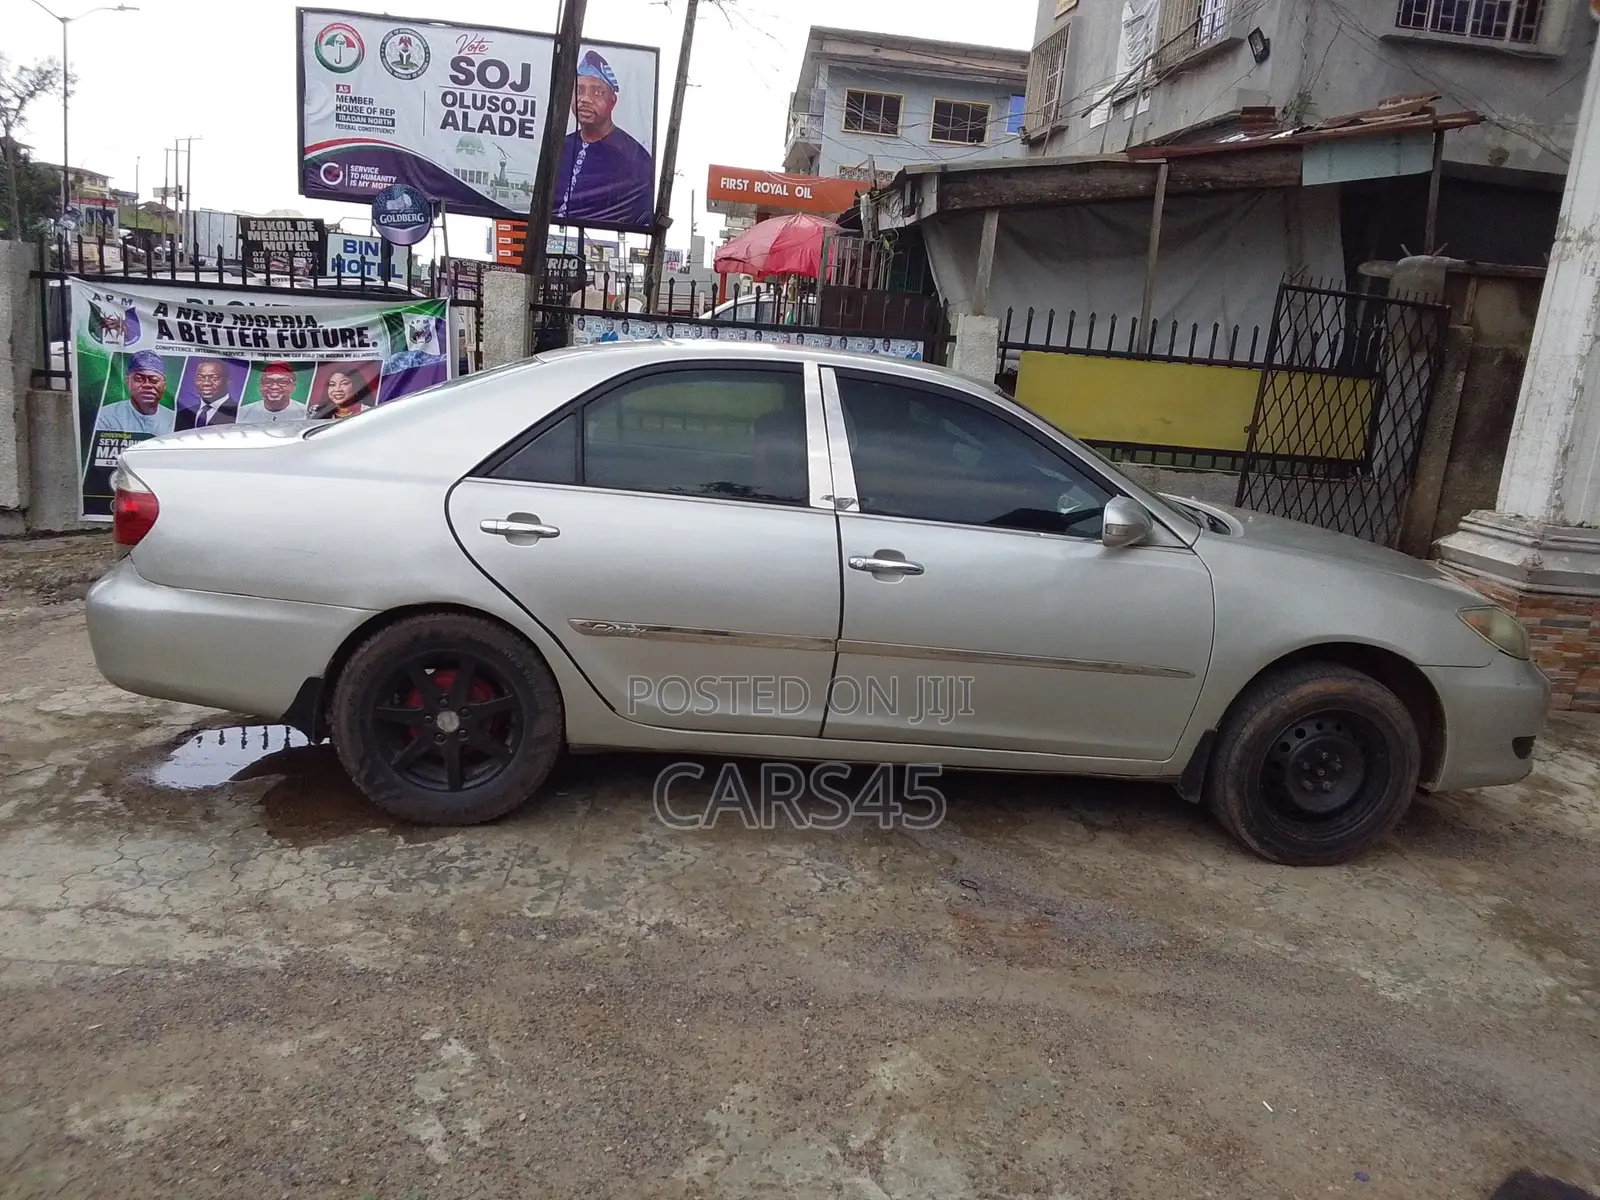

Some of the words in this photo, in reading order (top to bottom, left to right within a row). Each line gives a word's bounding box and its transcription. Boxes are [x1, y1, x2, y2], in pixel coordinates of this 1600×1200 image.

[455, 33, 493, 55] Vote
[449, 55, 531, 93] SOJ
[335, 94, 374, 106] MEMBER
[440, 90, 536, 118] OLUSOJI
[335, 103, 365, 115] HOUSE
[366, 106, 378, 115] OF
[379, 108, 396, 117] REP
[338, 114, 367, 123] IBADAN
[367, 118, 394, 126] NORTH
[439, 109, 535, 139] ALADE
[335, 123, 357, 131] FEDERAL
[357, 126, 396, 135] CONSTITUENCY
[350, 164, 380, 174] SERVICE
[350, 172, 360, 180] TO
[360, 173, 398, 184] HUMANITY
[357, 180, 370, 188] MY
[720, 177, 750, 192] FIRST
[754, 181, 789, 197] ROYAL
[794, 185, 813, 200] OIL
[380, 212, 425, 225] GOLDBERG
[249, 220, 295, 231] FAKOL
[296, 220, 316, 231] DE
[247, 230, 319, 242] MERIDIAN
[262, 241, 311, 252] MOTEL
[490, 264, 517, 273] CHOSEN
[153, 302, 169, 318] A
[176, 306, 225, 325] NEW
[231, 313, 324, 329] NIGERIA.
[156, 318, 175, 341] A
[177, 321, 270, 349] BETTER
[276, 326, 379, 350] FUTURE.
